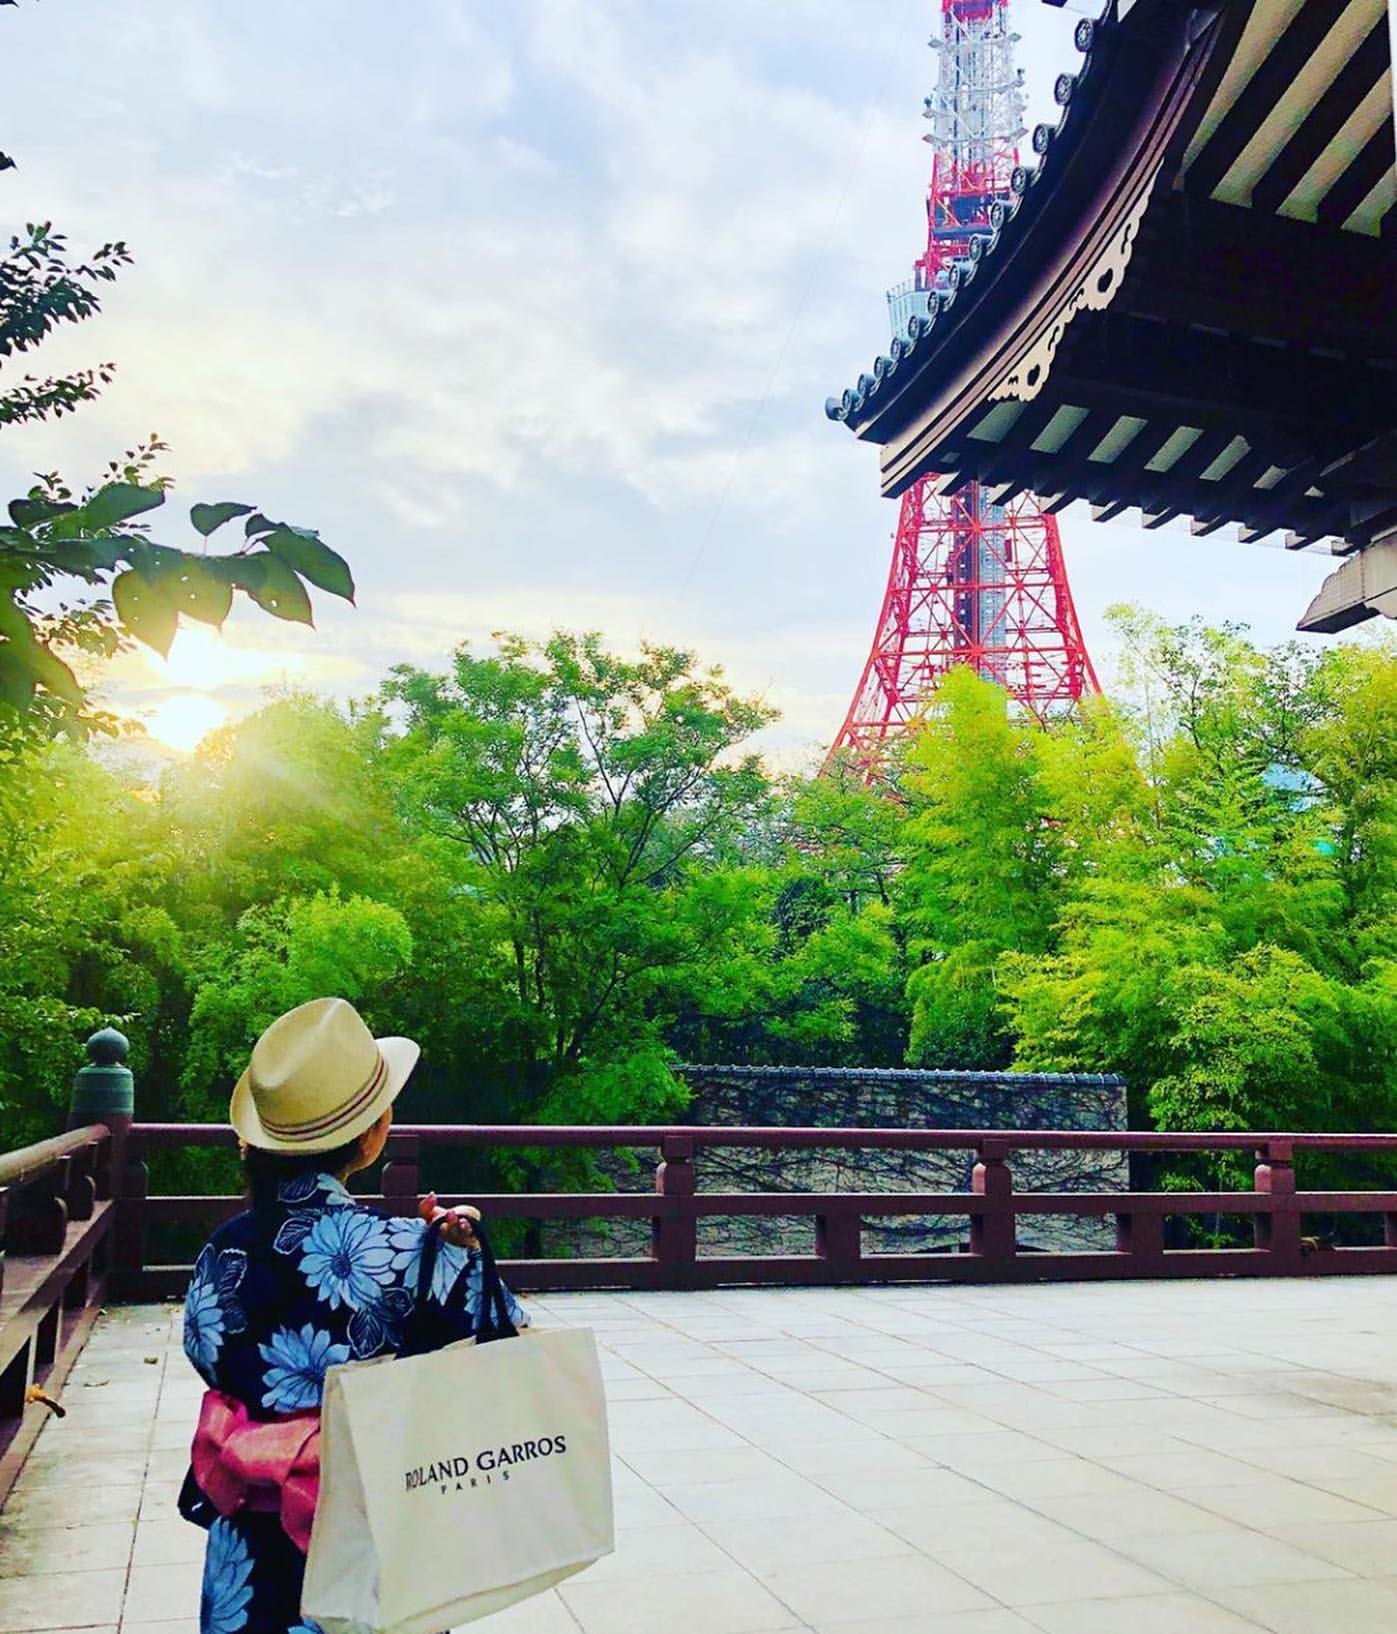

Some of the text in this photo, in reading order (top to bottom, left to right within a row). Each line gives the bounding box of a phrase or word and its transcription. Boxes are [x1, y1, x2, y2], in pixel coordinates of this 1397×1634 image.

[405, 1435, 567, 1491] ROLAND GARROS
[441, 1470, 510, 1494] PARIS
